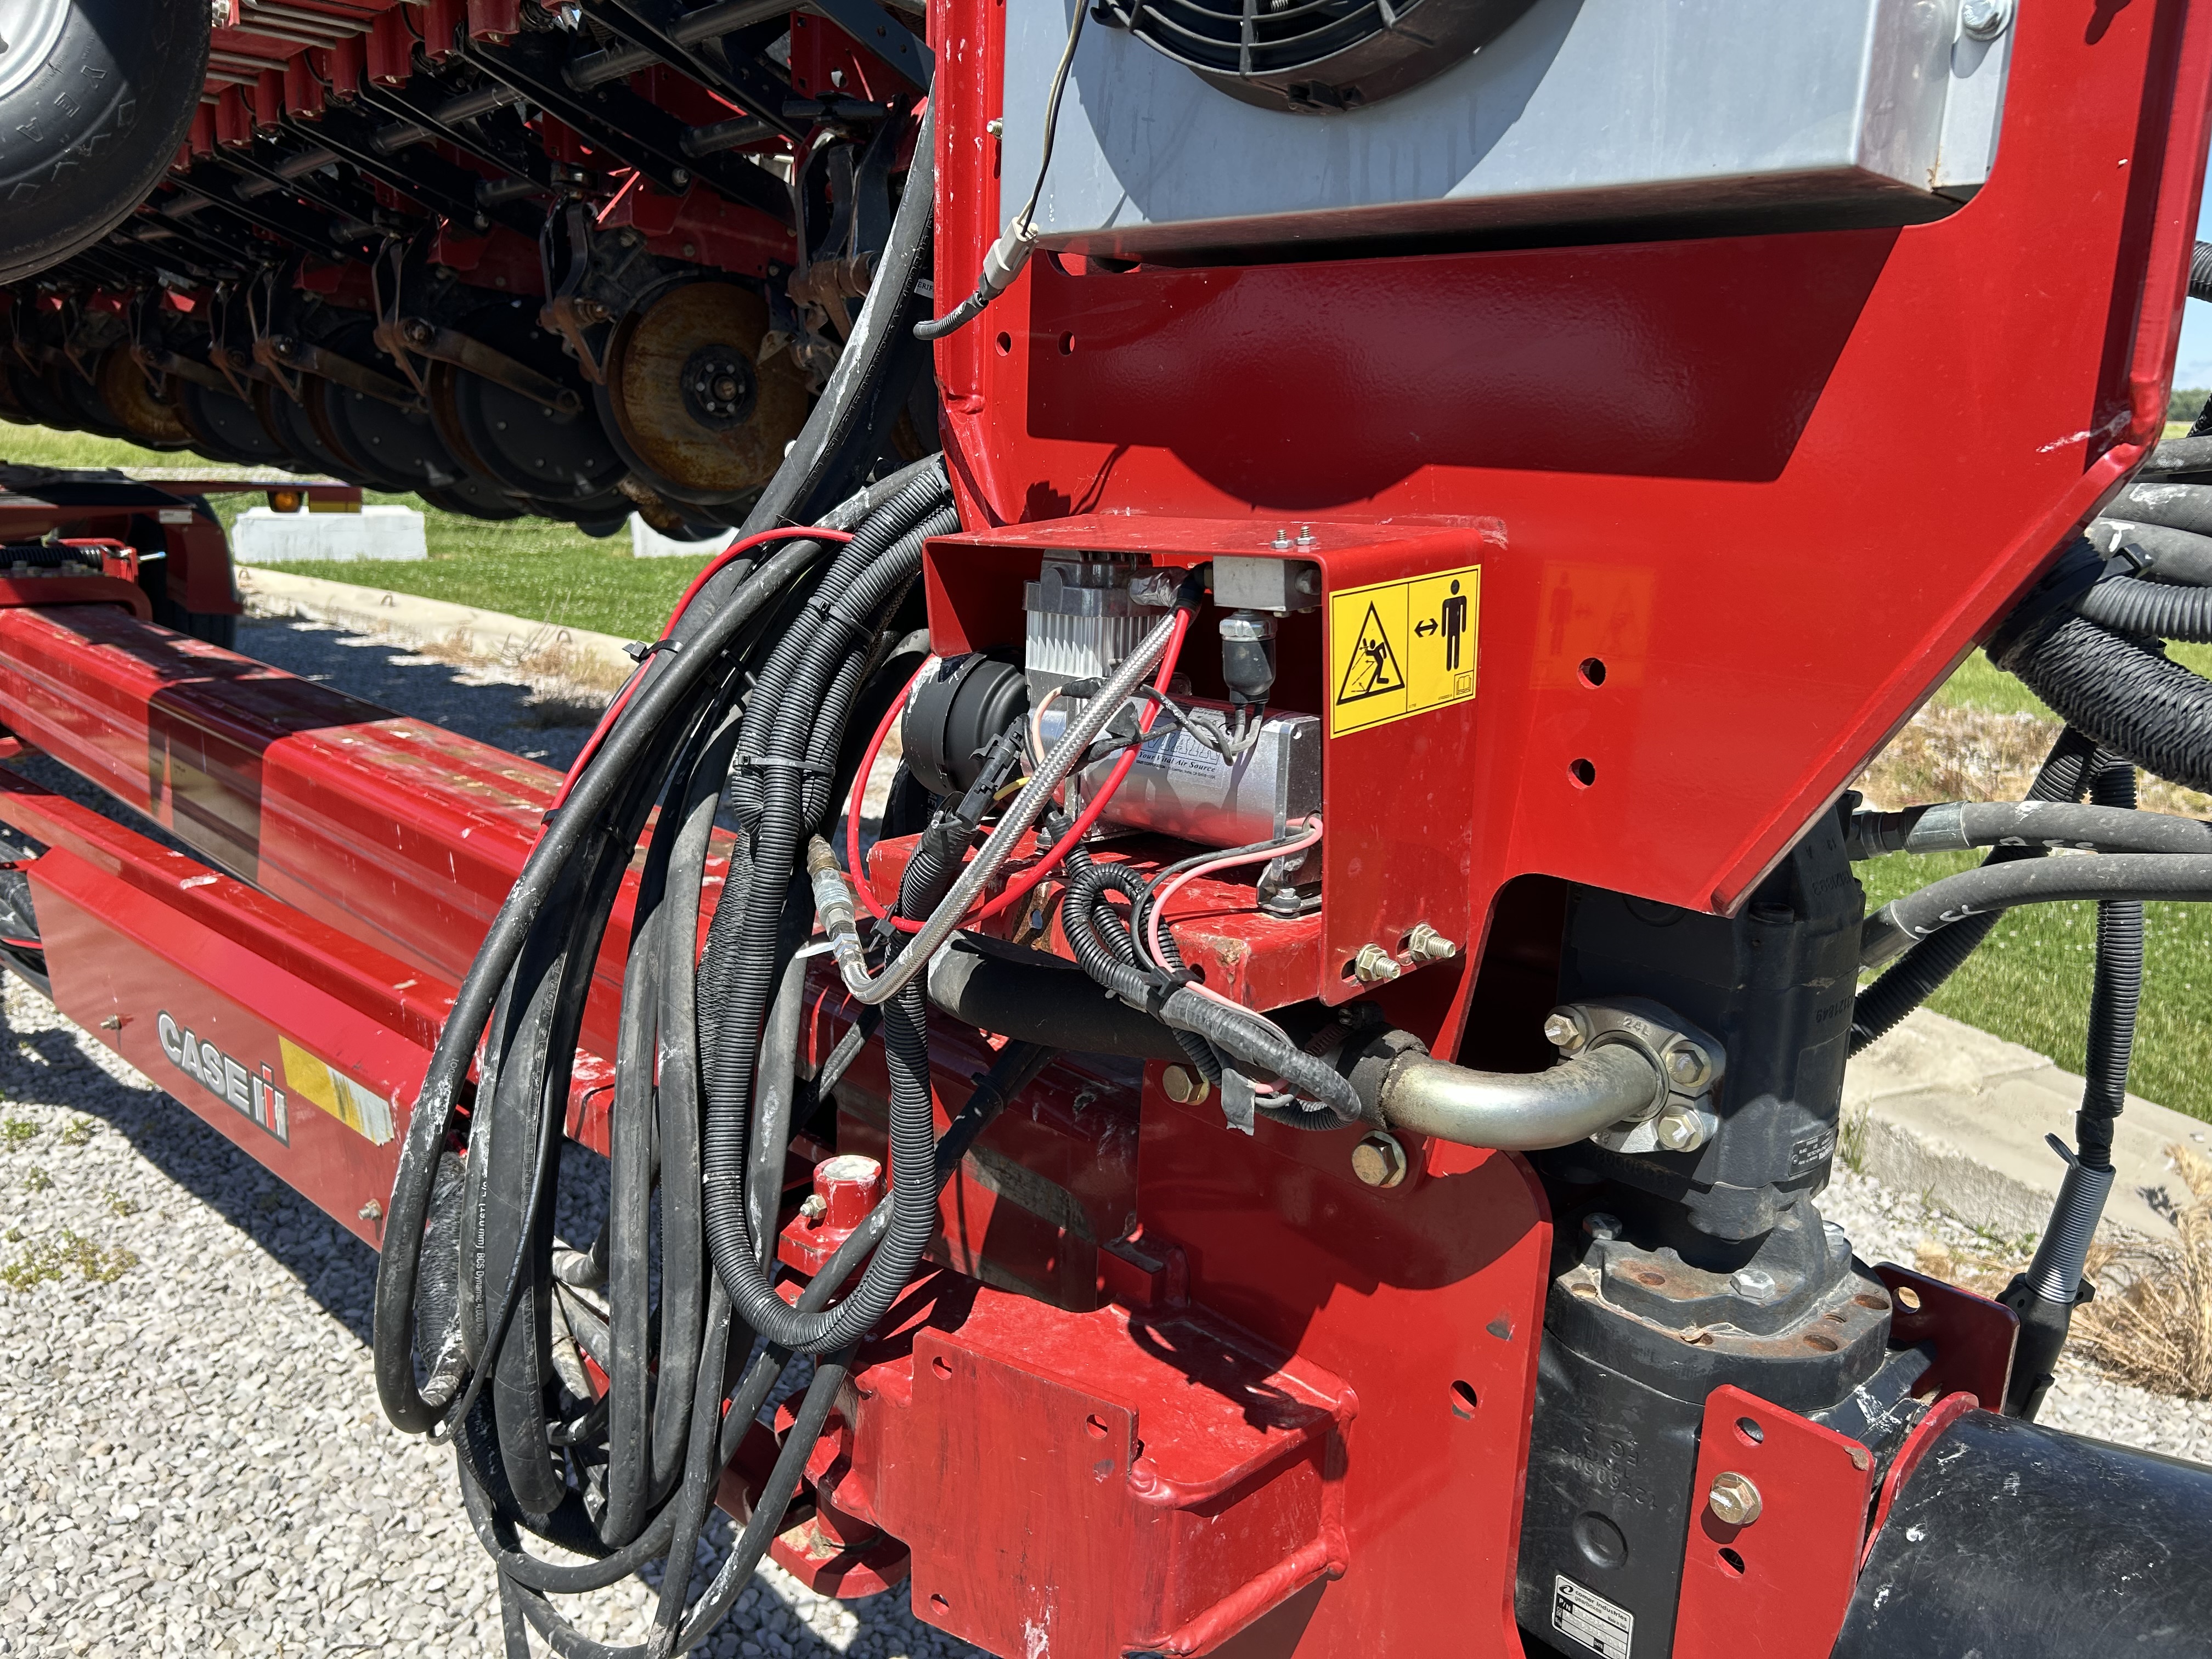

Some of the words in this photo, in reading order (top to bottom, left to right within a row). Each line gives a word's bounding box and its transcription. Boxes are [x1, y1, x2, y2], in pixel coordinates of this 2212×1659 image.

[917, 281, 934, 292] ERIF
[1138, 751, 1155, 760] Your
[1156, 755, 1173, 764] Vital
[1189, 761, 1216, 772] Source
[158, 1009, 251, 1115] CASE
[476, 1252, 486, 1270] BCS
[473, 1270, 485, 1303] Dynamic
[1559, 1598, 1571, 1611] P/N
[1575, 1596, 1602, 1614] gearboxes
[1575, 1590, 1594, 1604] comer
[1596, 1601, 1627, 1622] industries
